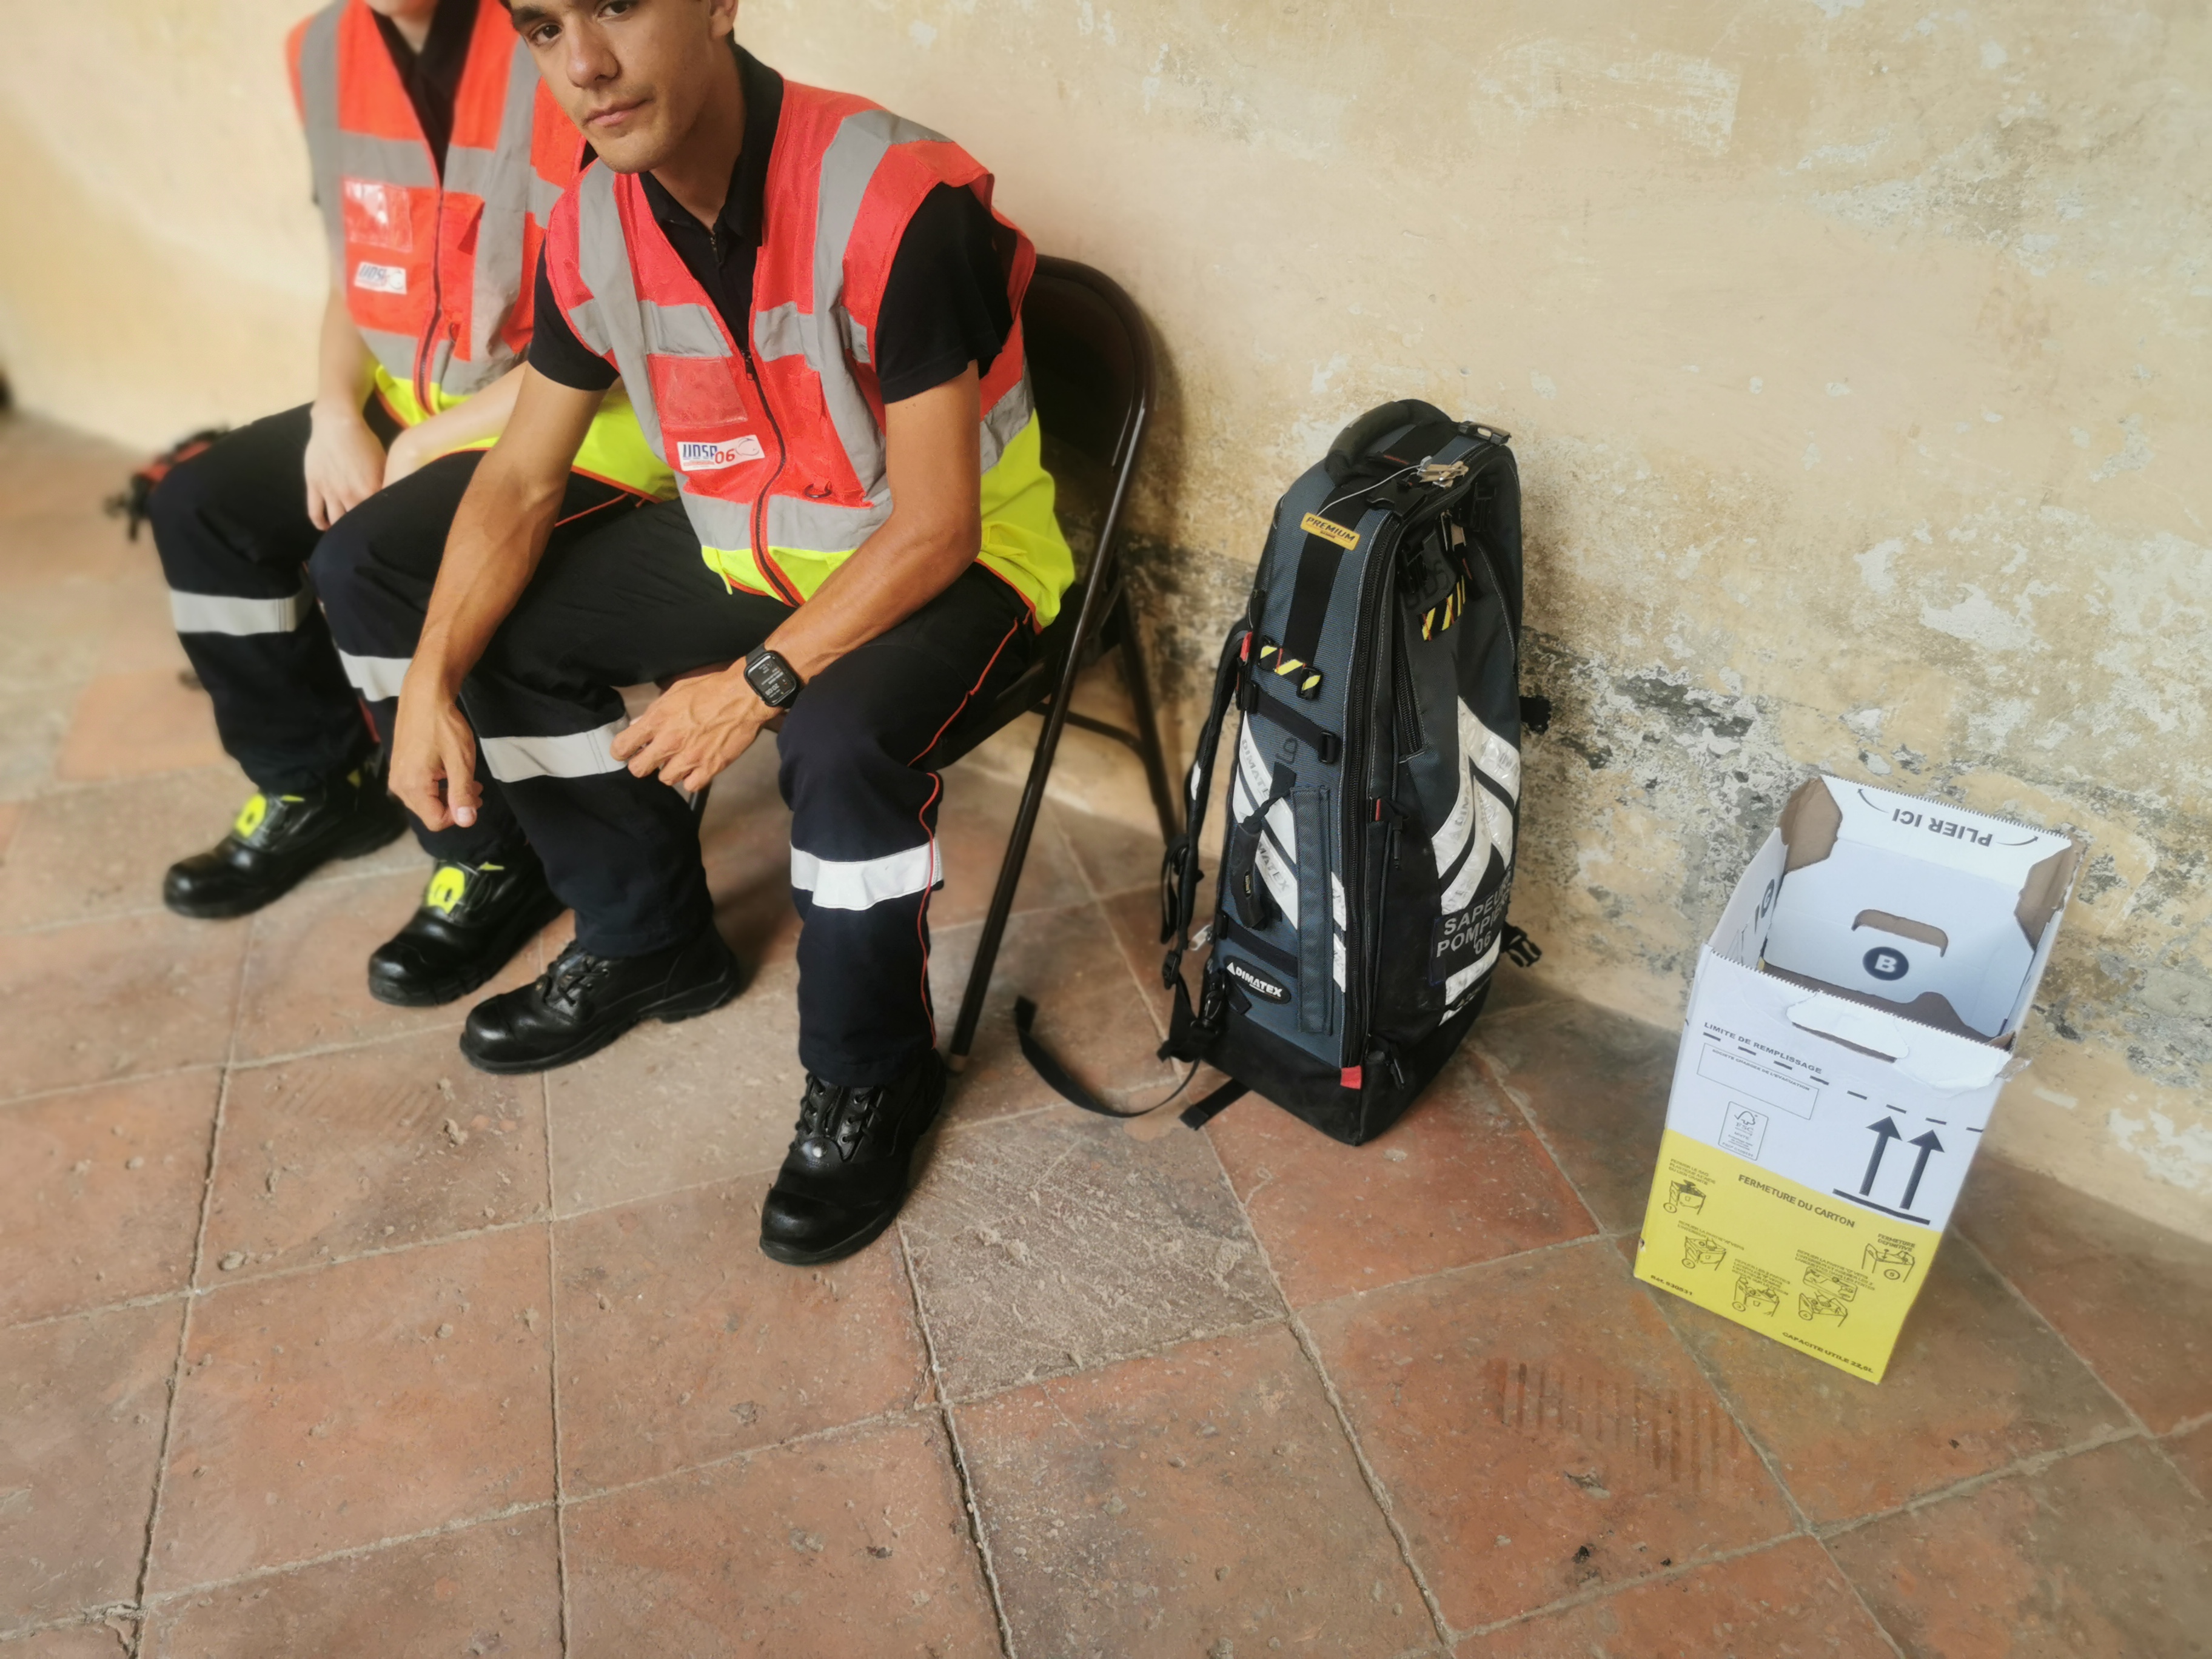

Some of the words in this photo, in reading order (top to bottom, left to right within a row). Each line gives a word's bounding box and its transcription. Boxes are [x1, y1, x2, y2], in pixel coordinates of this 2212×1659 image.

[715, 448, 736, 464] 06
[1306, 517, 1355, 541] PREMIUM
[1891, 807, 1922, 827] ICI
[1928, 817, 1993, 847] PLIER
[1474, 930, 1492, 955] 06
[1874, 954, 1897, 973] B
[1703, 1022, 1736, 1039] LIMITE
[1737, 1036, 1751, 1045] DE
[1752, 1042, 1822, 1074] REMPLISSAGE
[1737, 1173, 1796, 1204] FERMETURE
[1797, 1199, 1812, 1211] DU
[1813, 1205, 1855, 1228] CARTON
[1781, 1331, 1824, 1353] CAPACITE
[1824, 1349, 1849, 1363] UTILE
